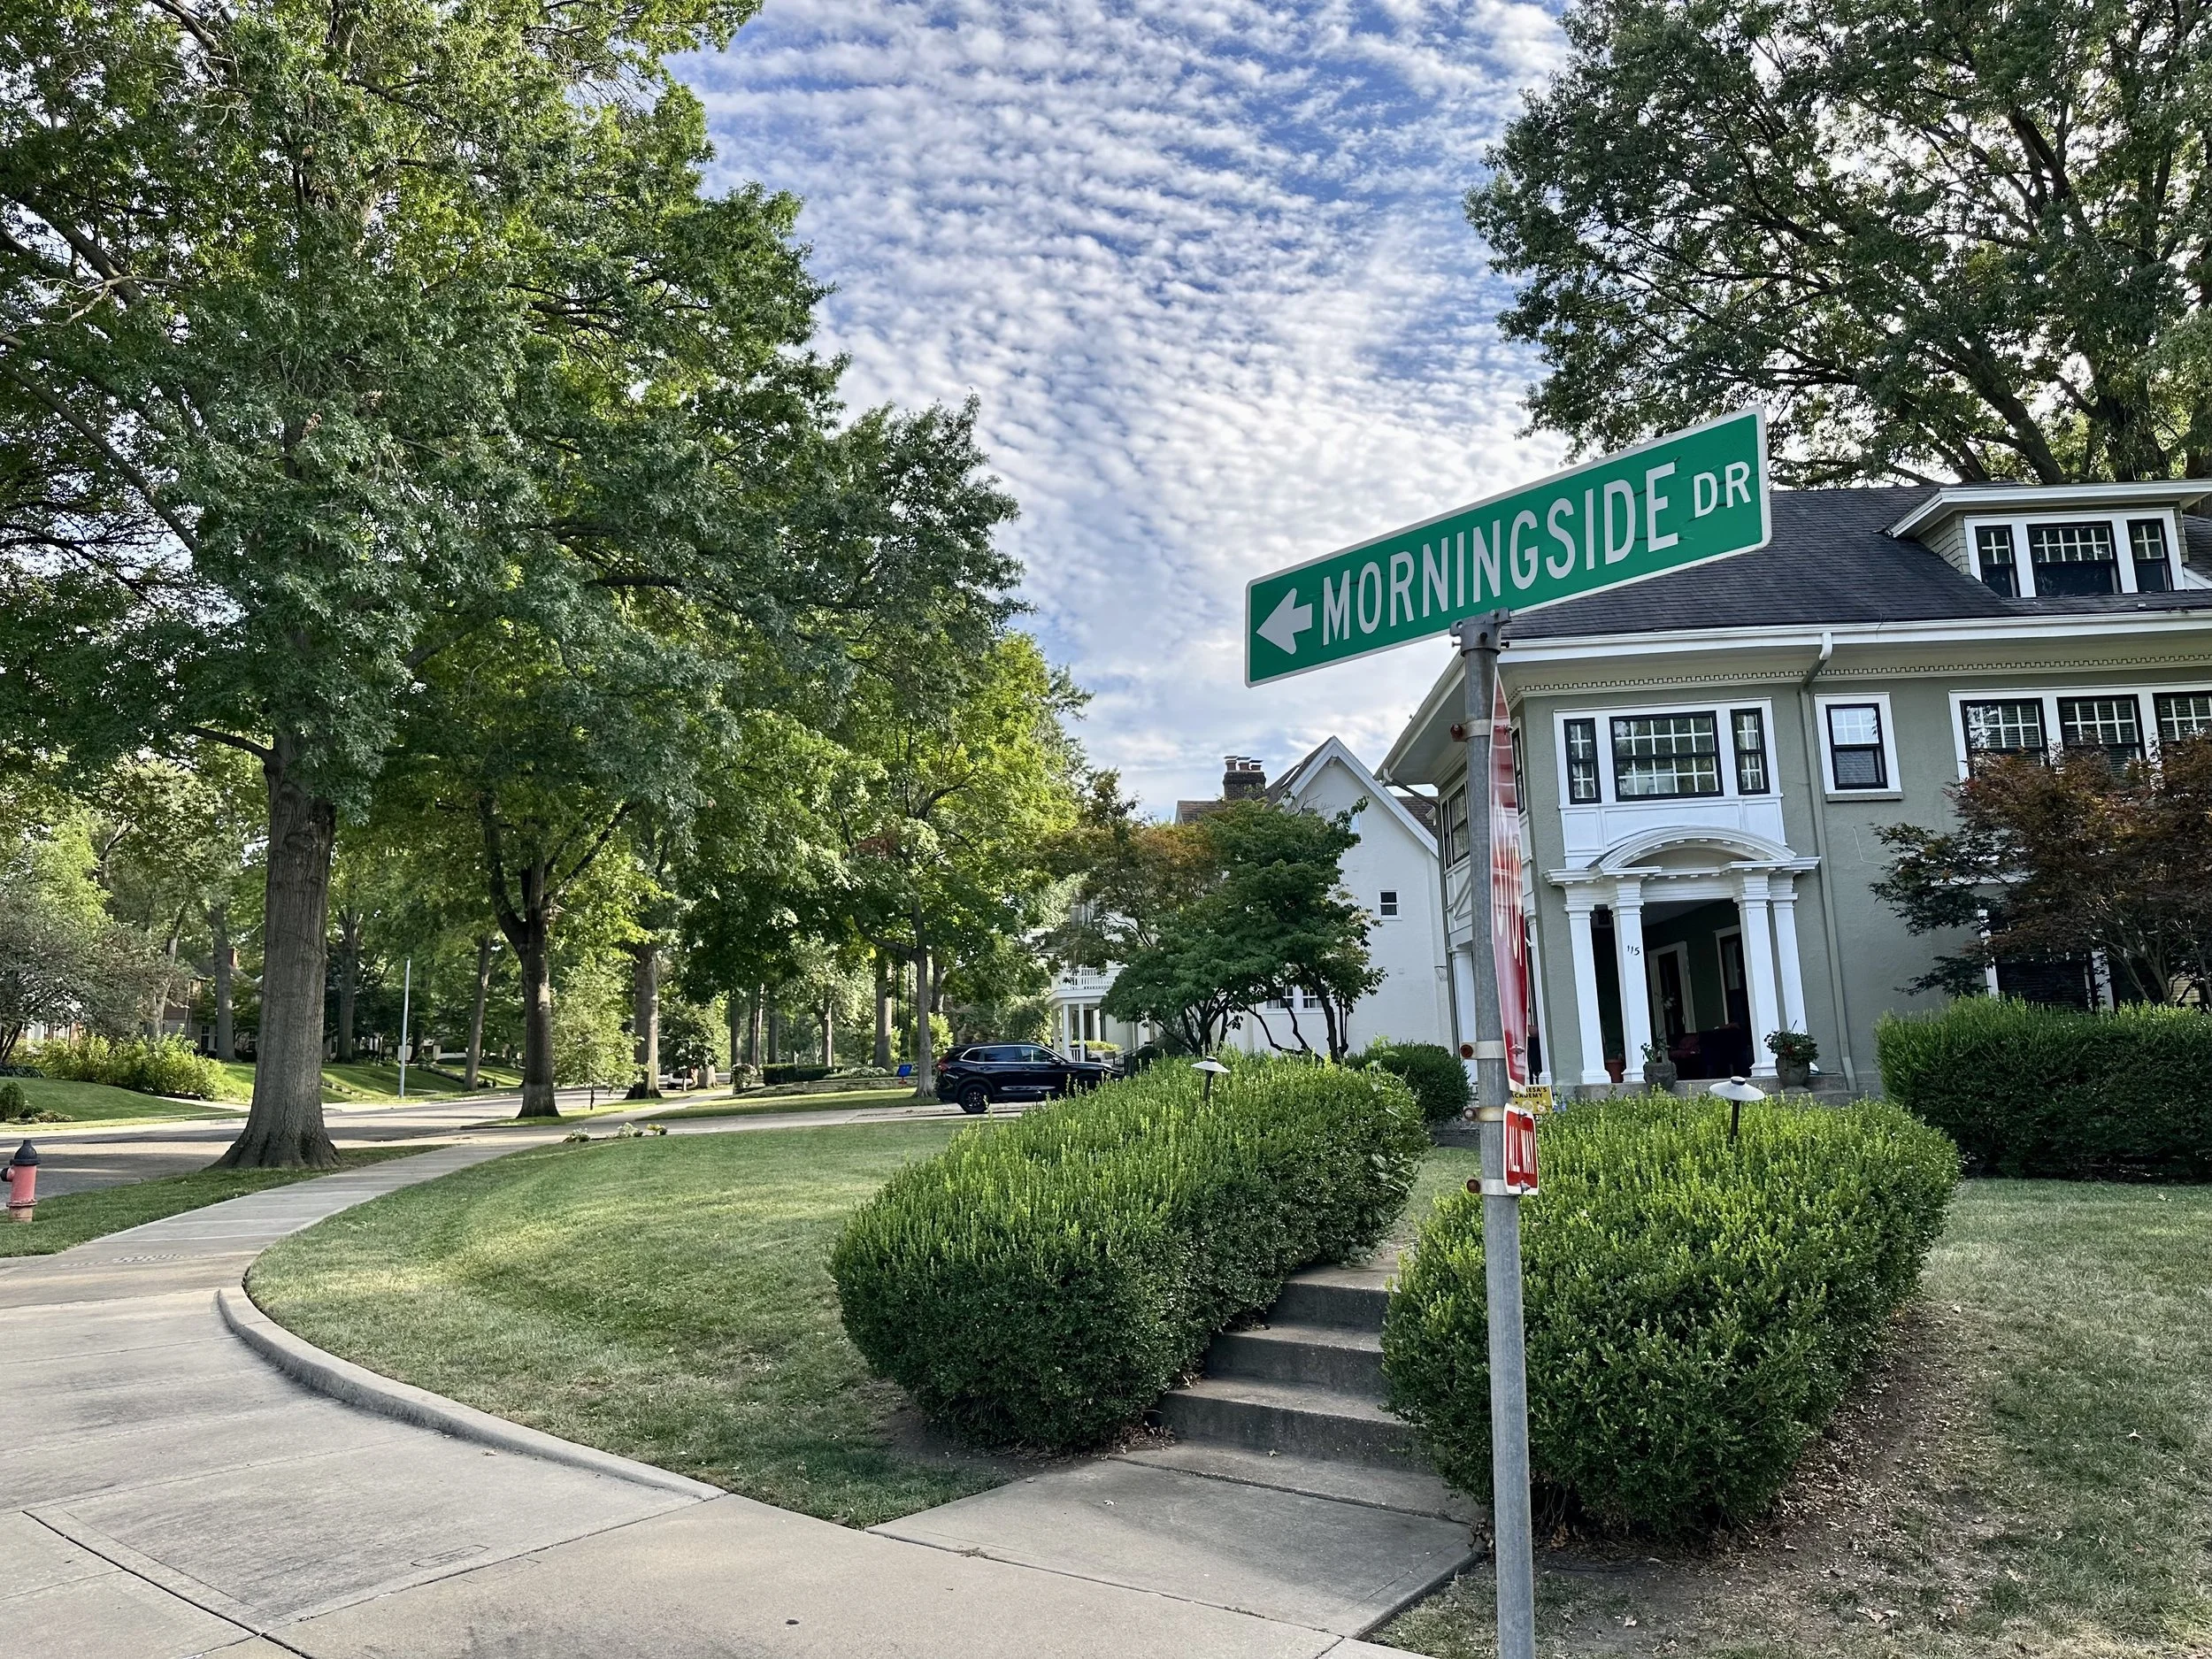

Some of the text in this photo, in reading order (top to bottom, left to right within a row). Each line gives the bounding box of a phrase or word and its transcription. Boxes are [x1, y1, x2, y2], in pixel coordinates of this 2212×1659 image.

[1323, 461, 1751, 645] MORNINGSIDE DR
[1494, 789, 1522, 966] STOP
[1626, 944, 1640, 956] 115
[1509, 1125, 1535, 1175] ALL WAY
